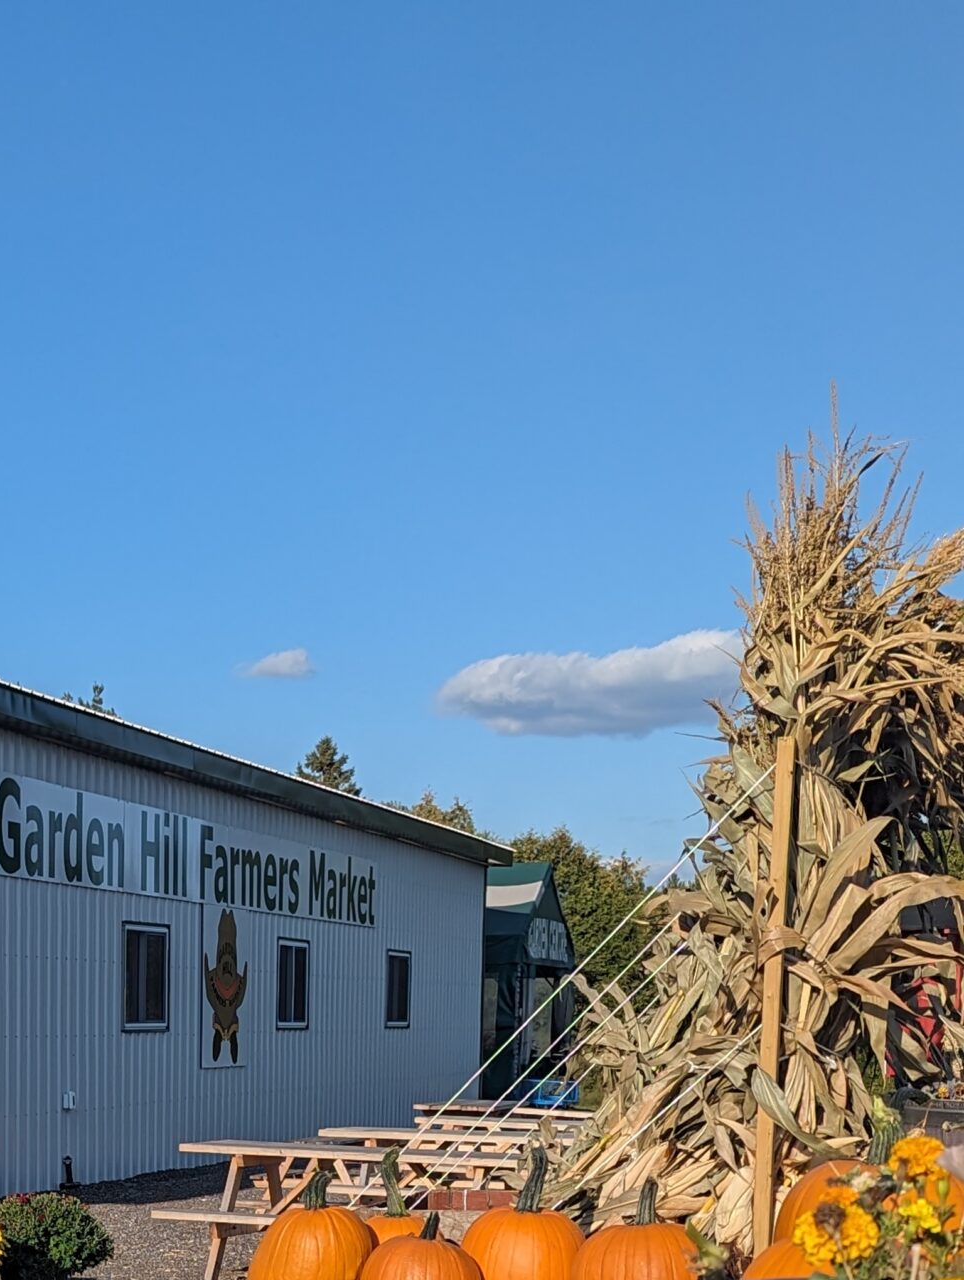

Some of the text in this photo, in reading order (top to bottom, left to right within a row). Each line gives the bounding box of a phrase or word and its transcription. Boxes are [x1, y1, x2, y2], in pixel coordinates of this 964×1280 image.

[141, 810, 187, 897] Hill
[200, 824, 300, 915] Farmers
[308, 850, 376, 926] Market
